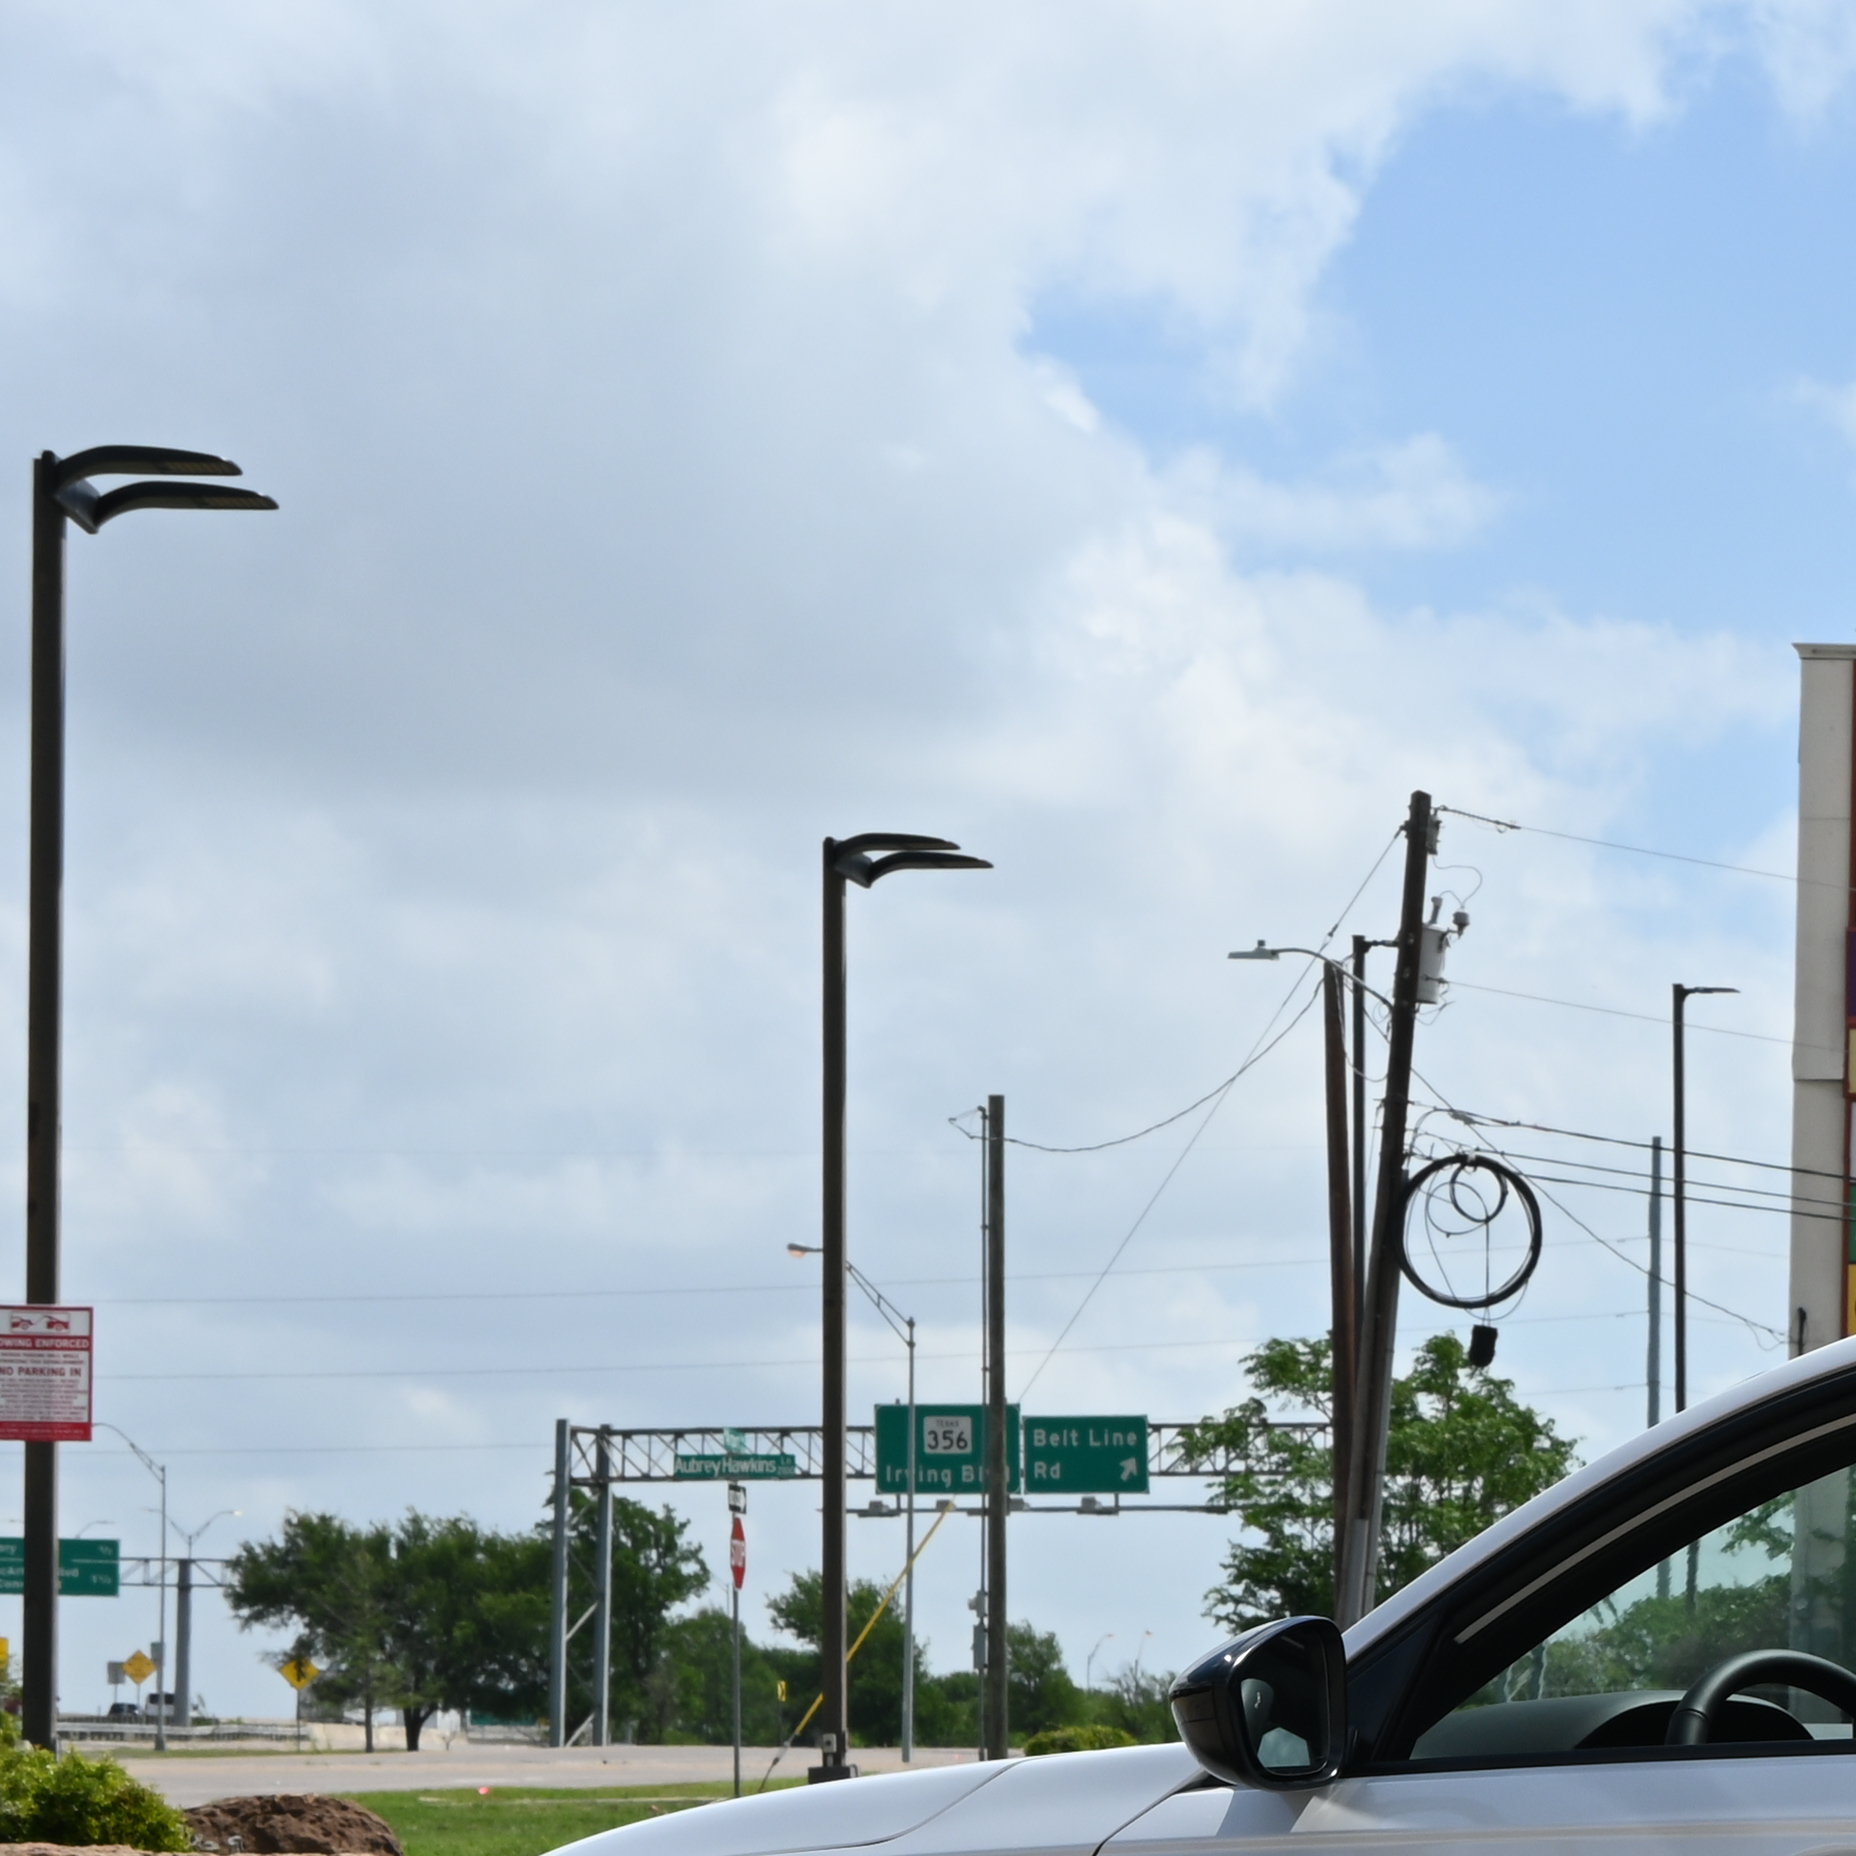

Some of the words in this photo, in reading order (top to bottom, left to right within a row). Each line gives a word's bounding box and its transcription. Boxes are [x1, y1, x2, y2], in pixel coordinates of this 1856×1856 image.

[18, 1367, 66, 1376] PARKING
[927, 1430, 968, 1450] 356
[1033, 1428, 1079, 1447] Belt
[1088, 1428, 1138, 1447] Line
[674, 1457, 722, 1476] Aubrey
[722, 1456, 777, 1473] Hawkins
[1034, 1461, 1061, 1480] Rd
